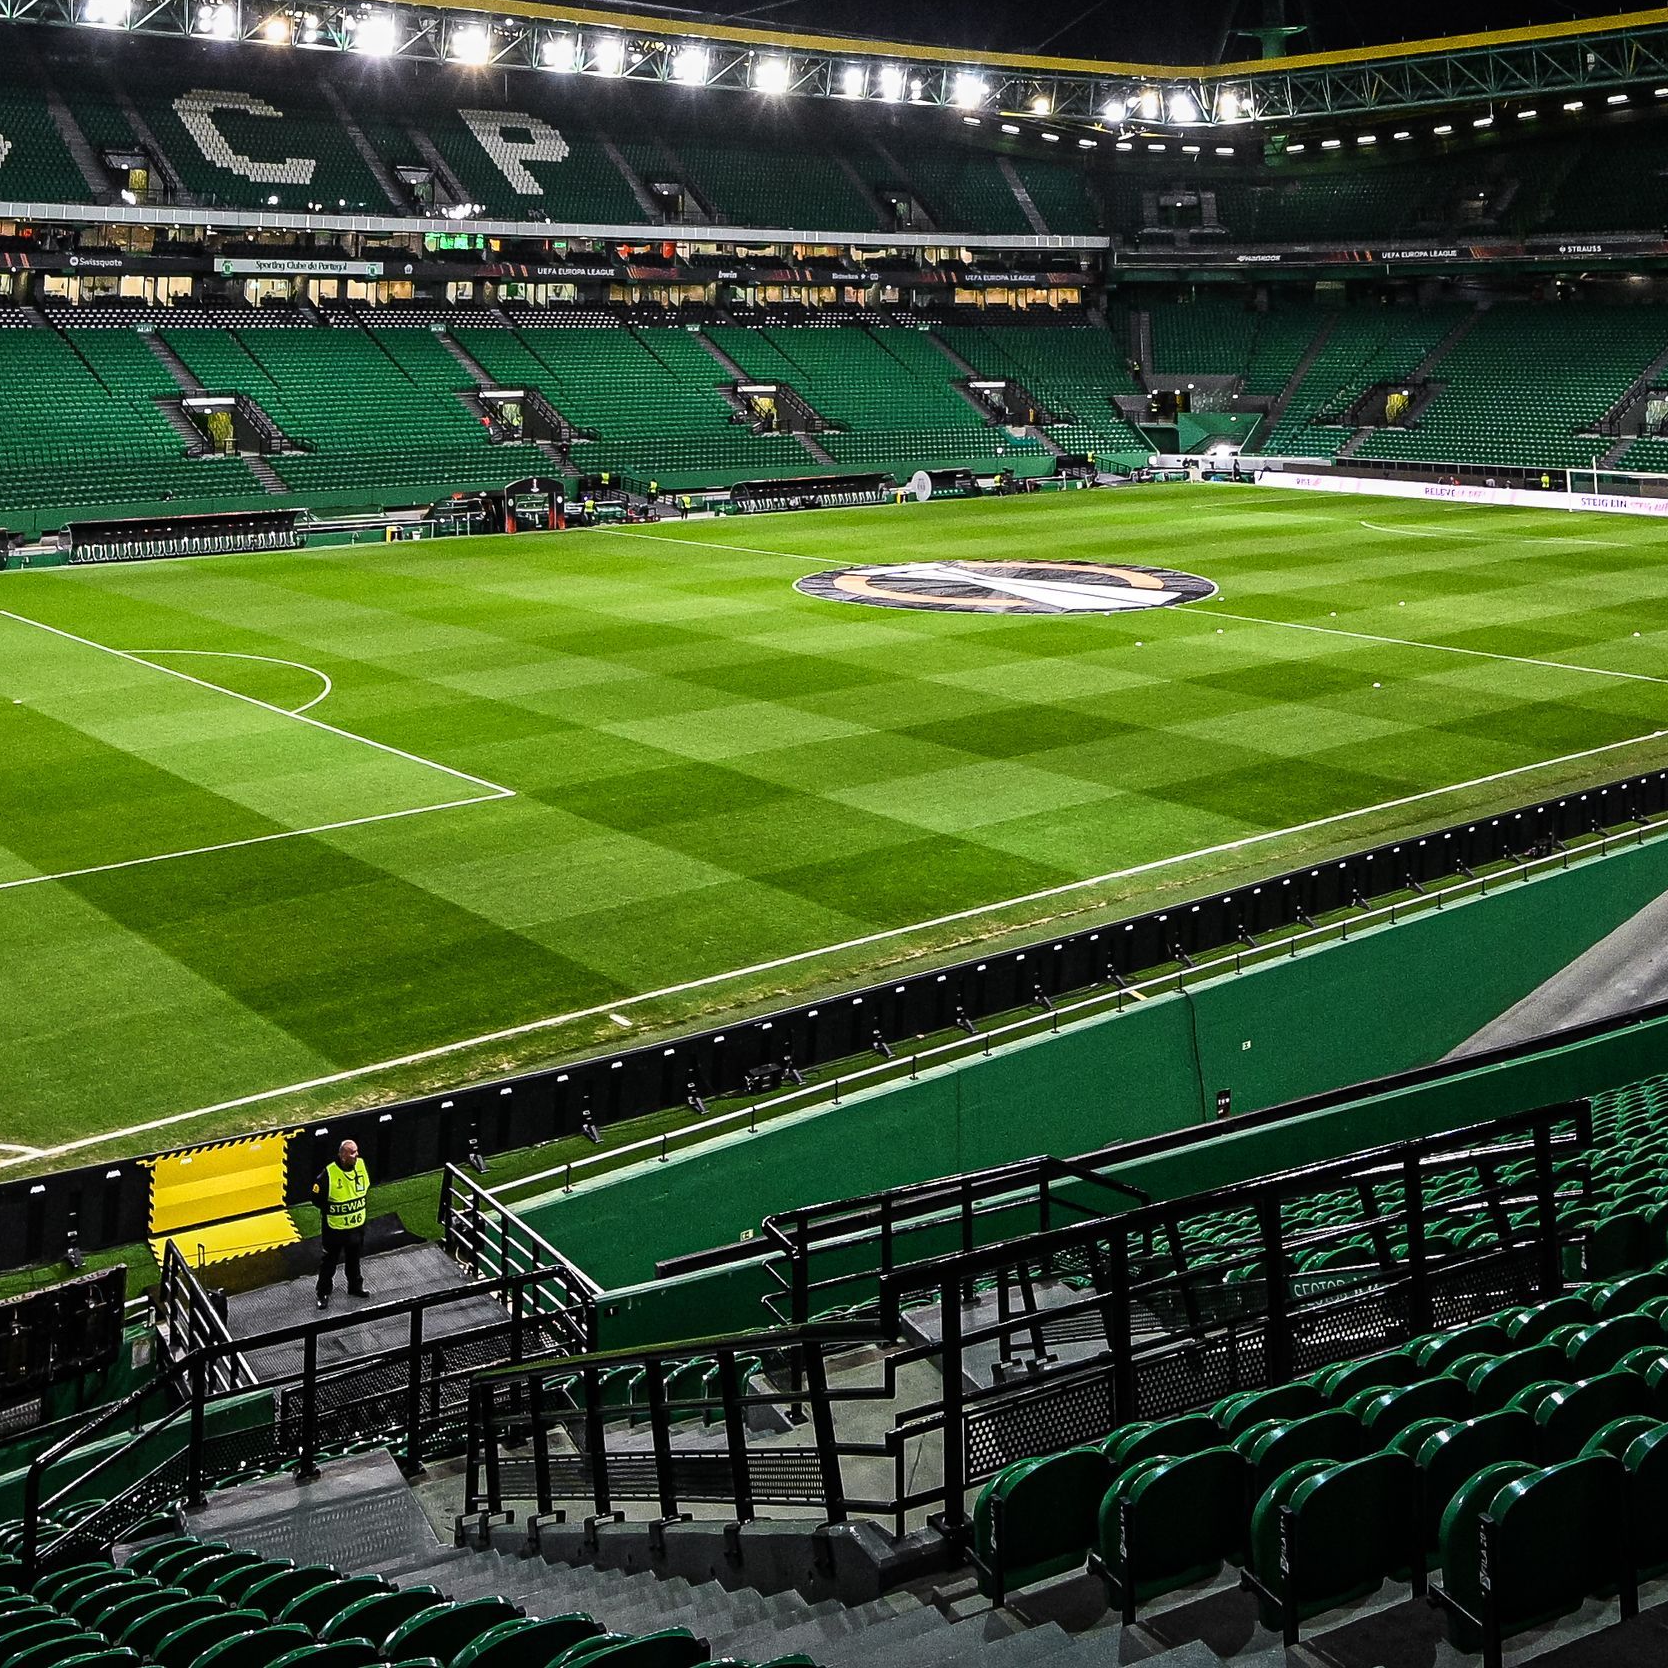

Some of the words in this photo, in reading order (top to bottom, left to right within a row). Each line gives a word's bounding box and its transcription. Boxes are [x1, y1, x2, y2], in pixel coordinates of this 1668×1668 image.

[1382, 251, 1399, 259] UEFA
[558, 268, 586, 276] EUROPA
[343, 1213, 363, 1226] 146
